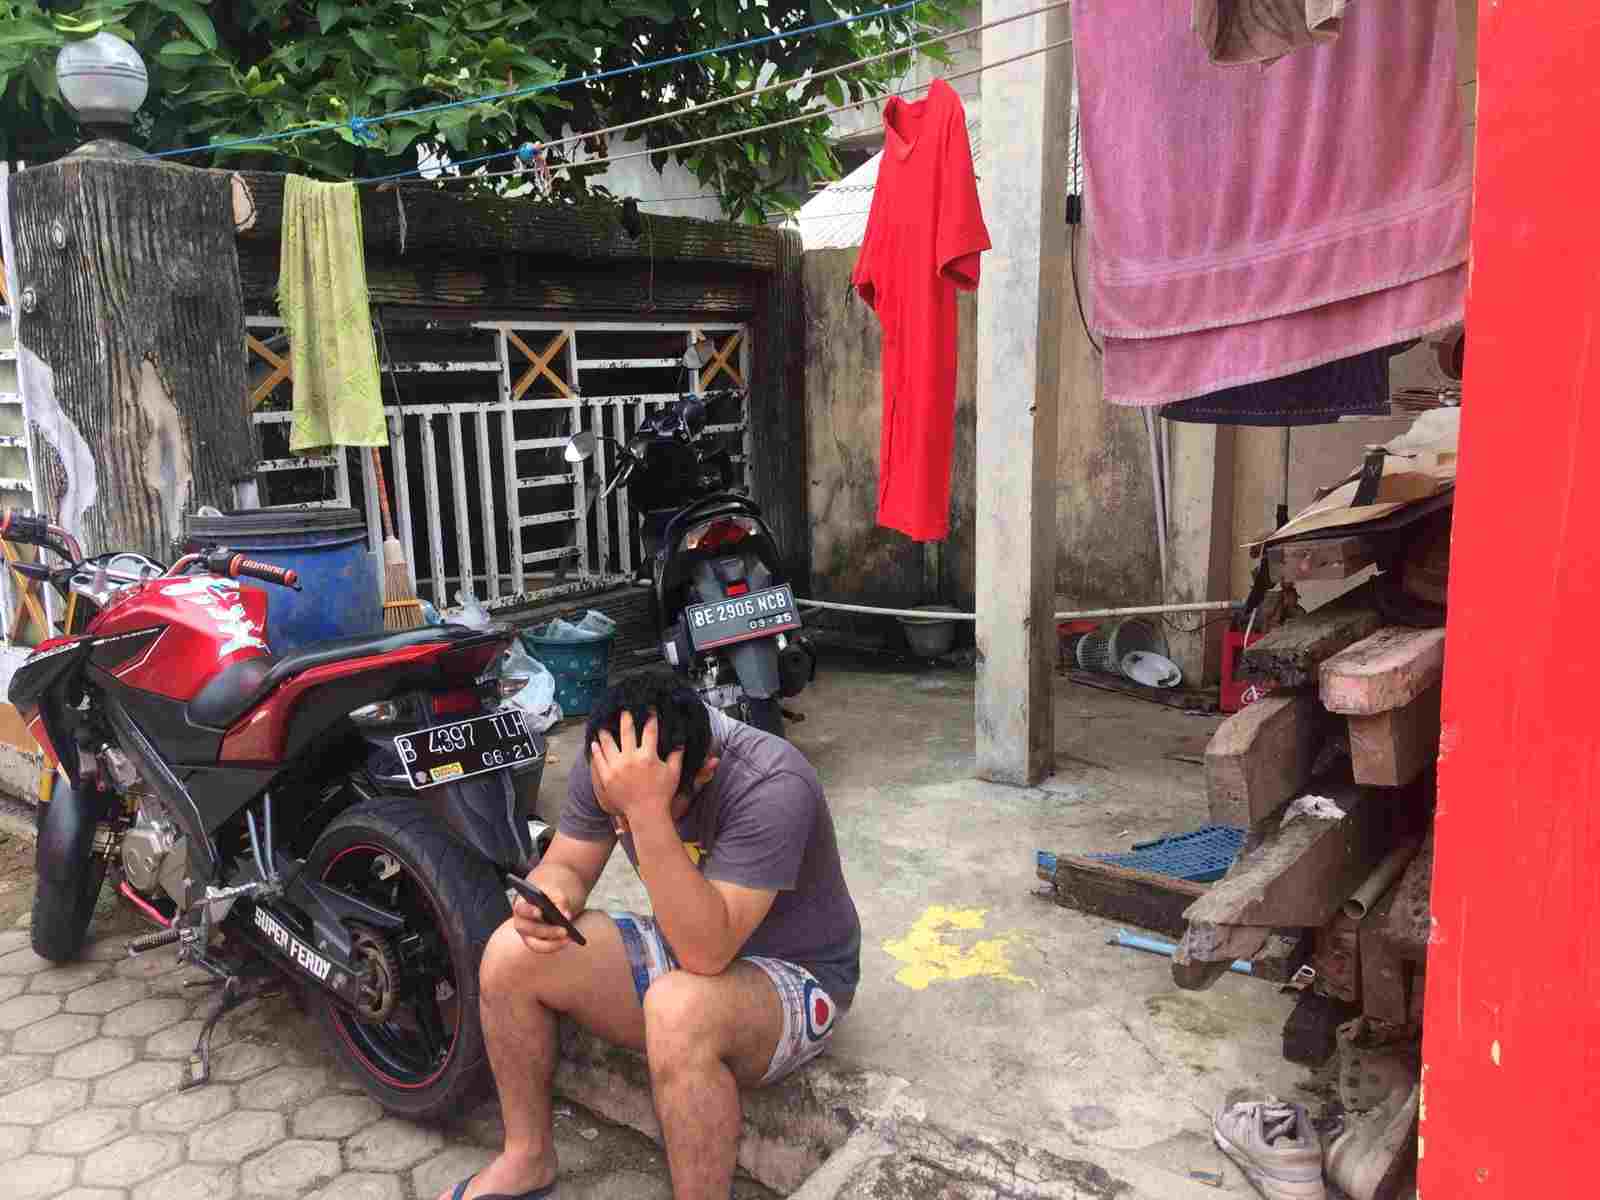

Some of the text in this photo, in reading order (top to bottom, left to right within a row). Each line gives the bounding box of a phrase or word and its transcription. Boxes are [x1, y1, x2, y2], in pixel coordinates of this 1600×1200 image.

[695, 592, 786, 627] BE 2906 NCB
[399, 710, 529, 762] B 4397 TLH
[254, 905, 289, 951] SUPER
